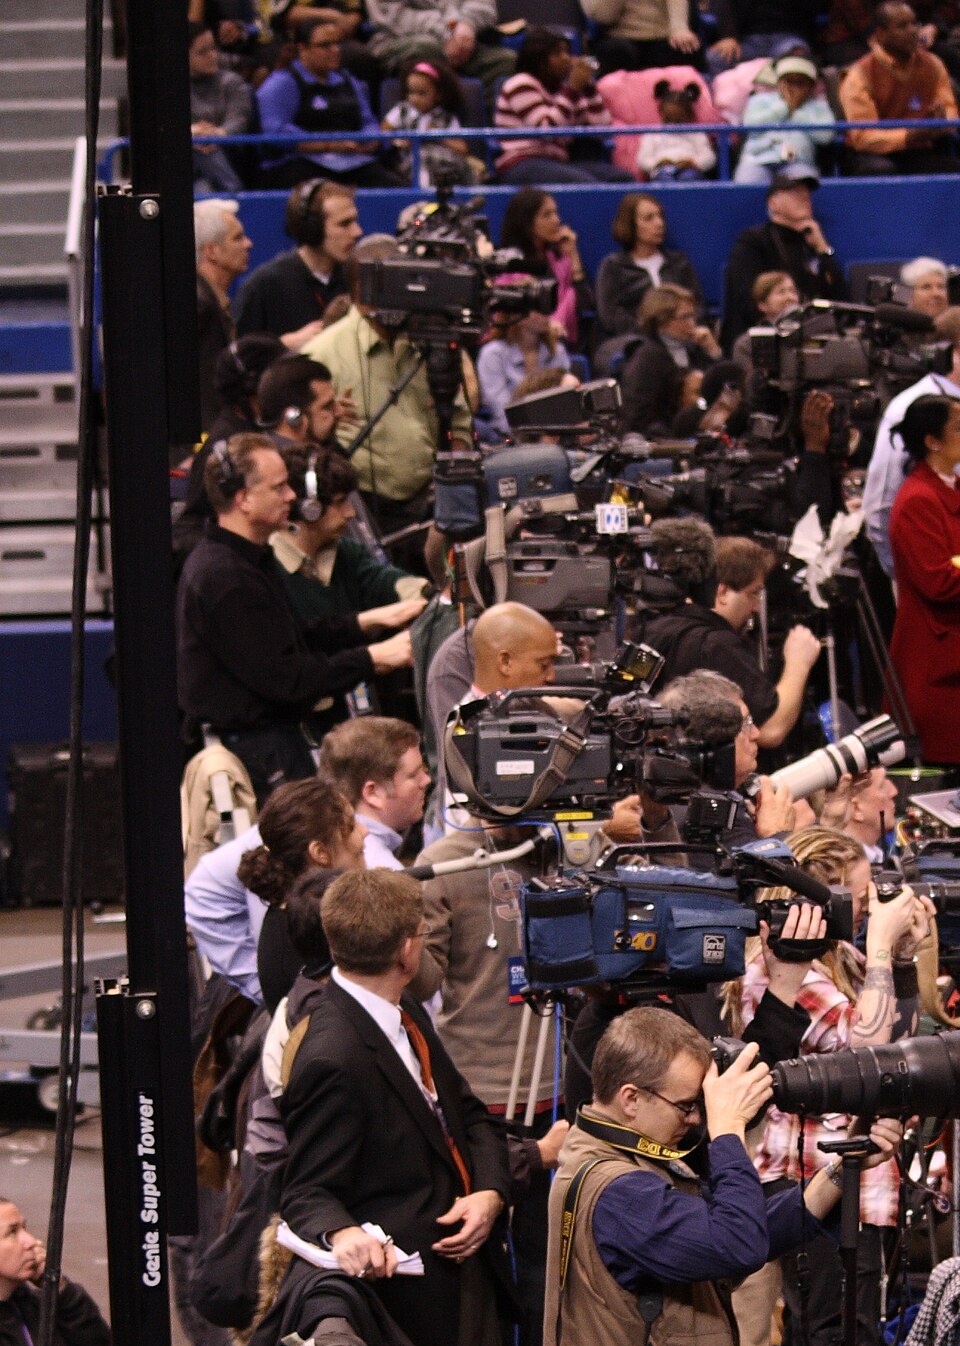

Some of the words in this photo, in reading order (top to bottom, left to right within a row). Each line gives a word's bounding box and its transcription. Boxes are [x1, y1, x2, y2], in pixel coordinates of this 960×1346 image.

[137, 1094, 155, 1156] Tower
[140, 1161, 161, 1224] Super
[142, 1230, 162, 1287] Genie
